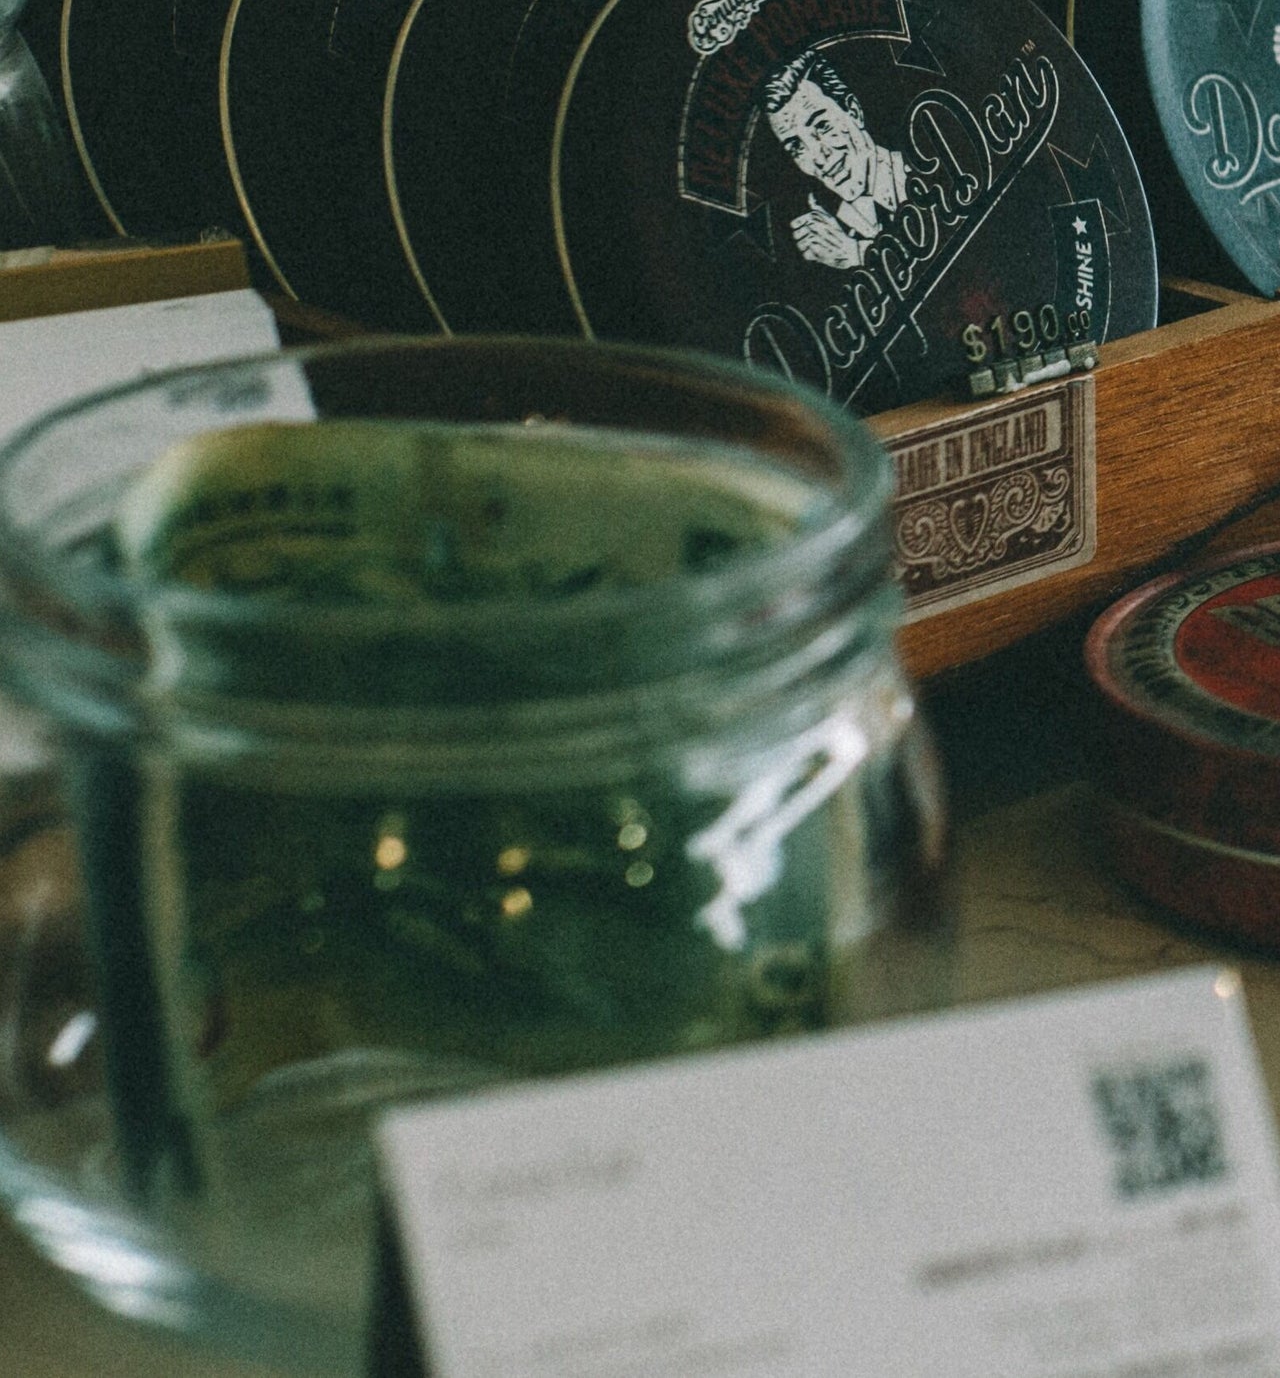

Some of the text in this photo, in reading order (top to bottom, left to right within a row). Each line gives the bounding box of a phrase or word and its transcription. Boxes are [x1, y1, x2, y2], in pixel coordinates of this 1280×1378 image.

[743, 170, 975, 402] Dapper
[908, 54, 1061, 205] Dan
[1075, 240, 1094, 312] SHINE
[968, 408, 1048, 474] ENGLAND
